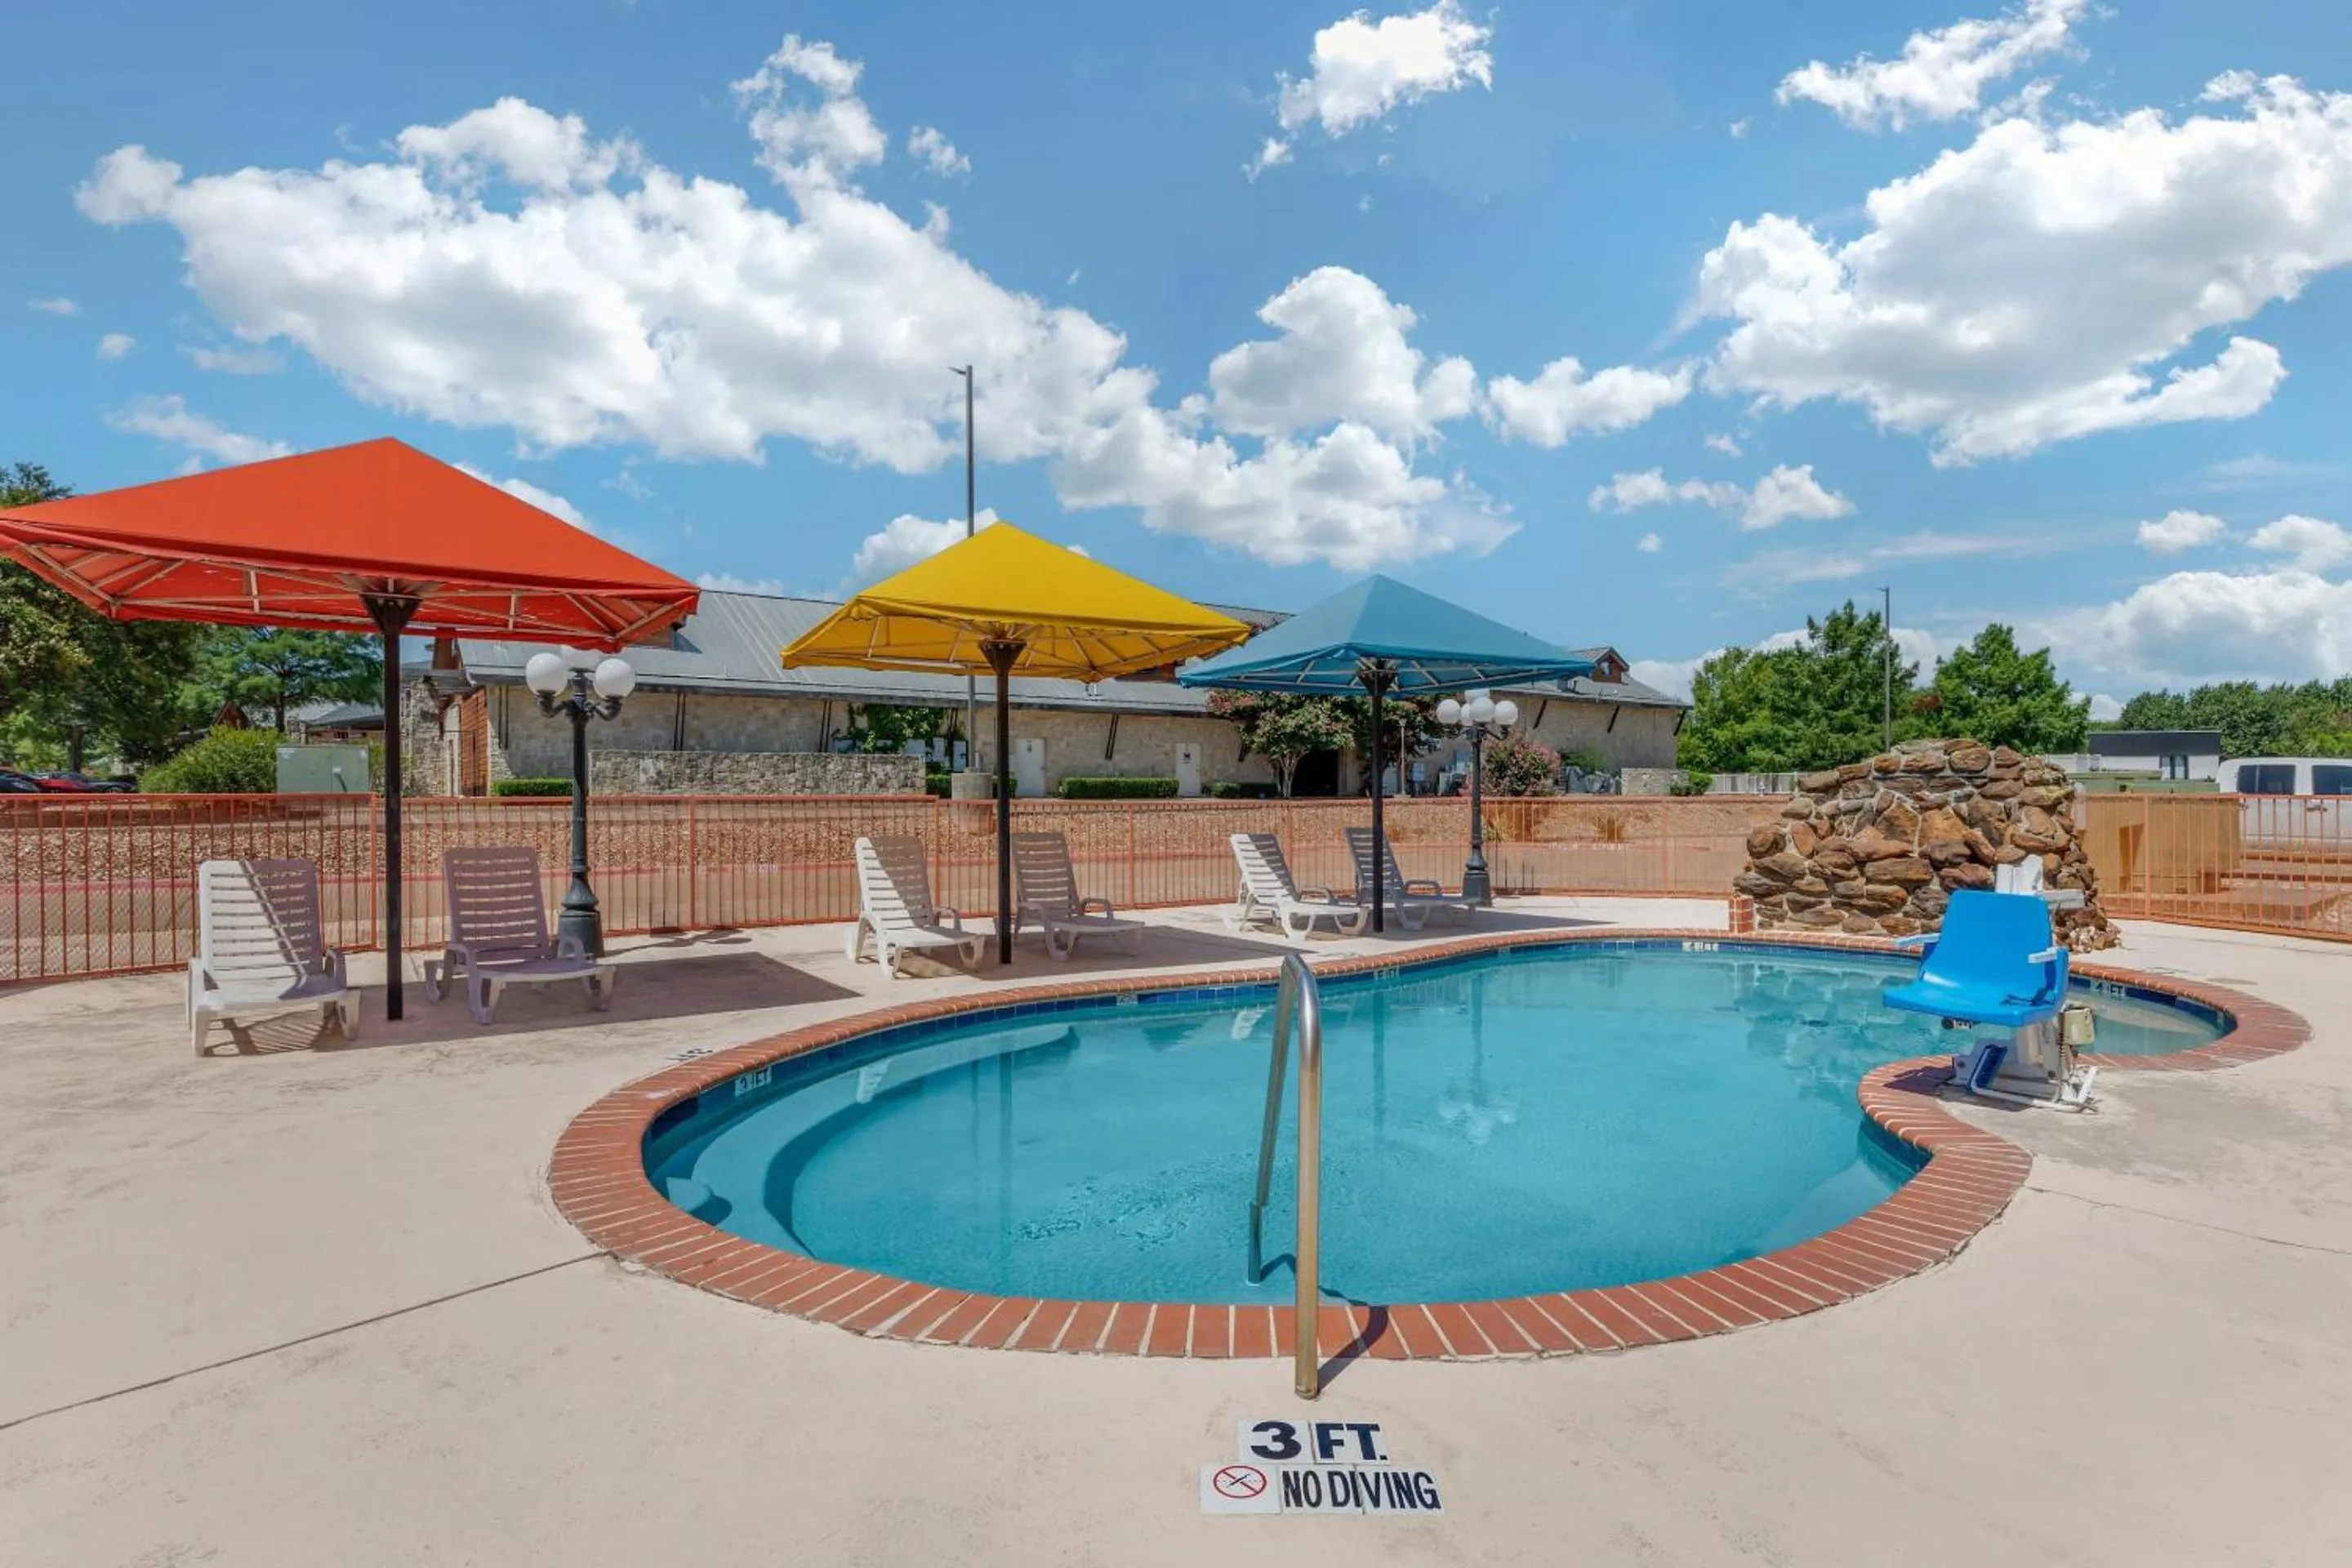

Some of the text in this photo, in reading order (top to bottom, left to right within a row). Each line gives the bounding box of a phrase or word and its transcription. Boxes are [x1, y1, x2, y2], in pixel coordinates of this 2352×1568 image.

[1250, 1421, 1388, 1460] 3 FT.
[1281, 1470, 1441, 1509] NO DIVING
